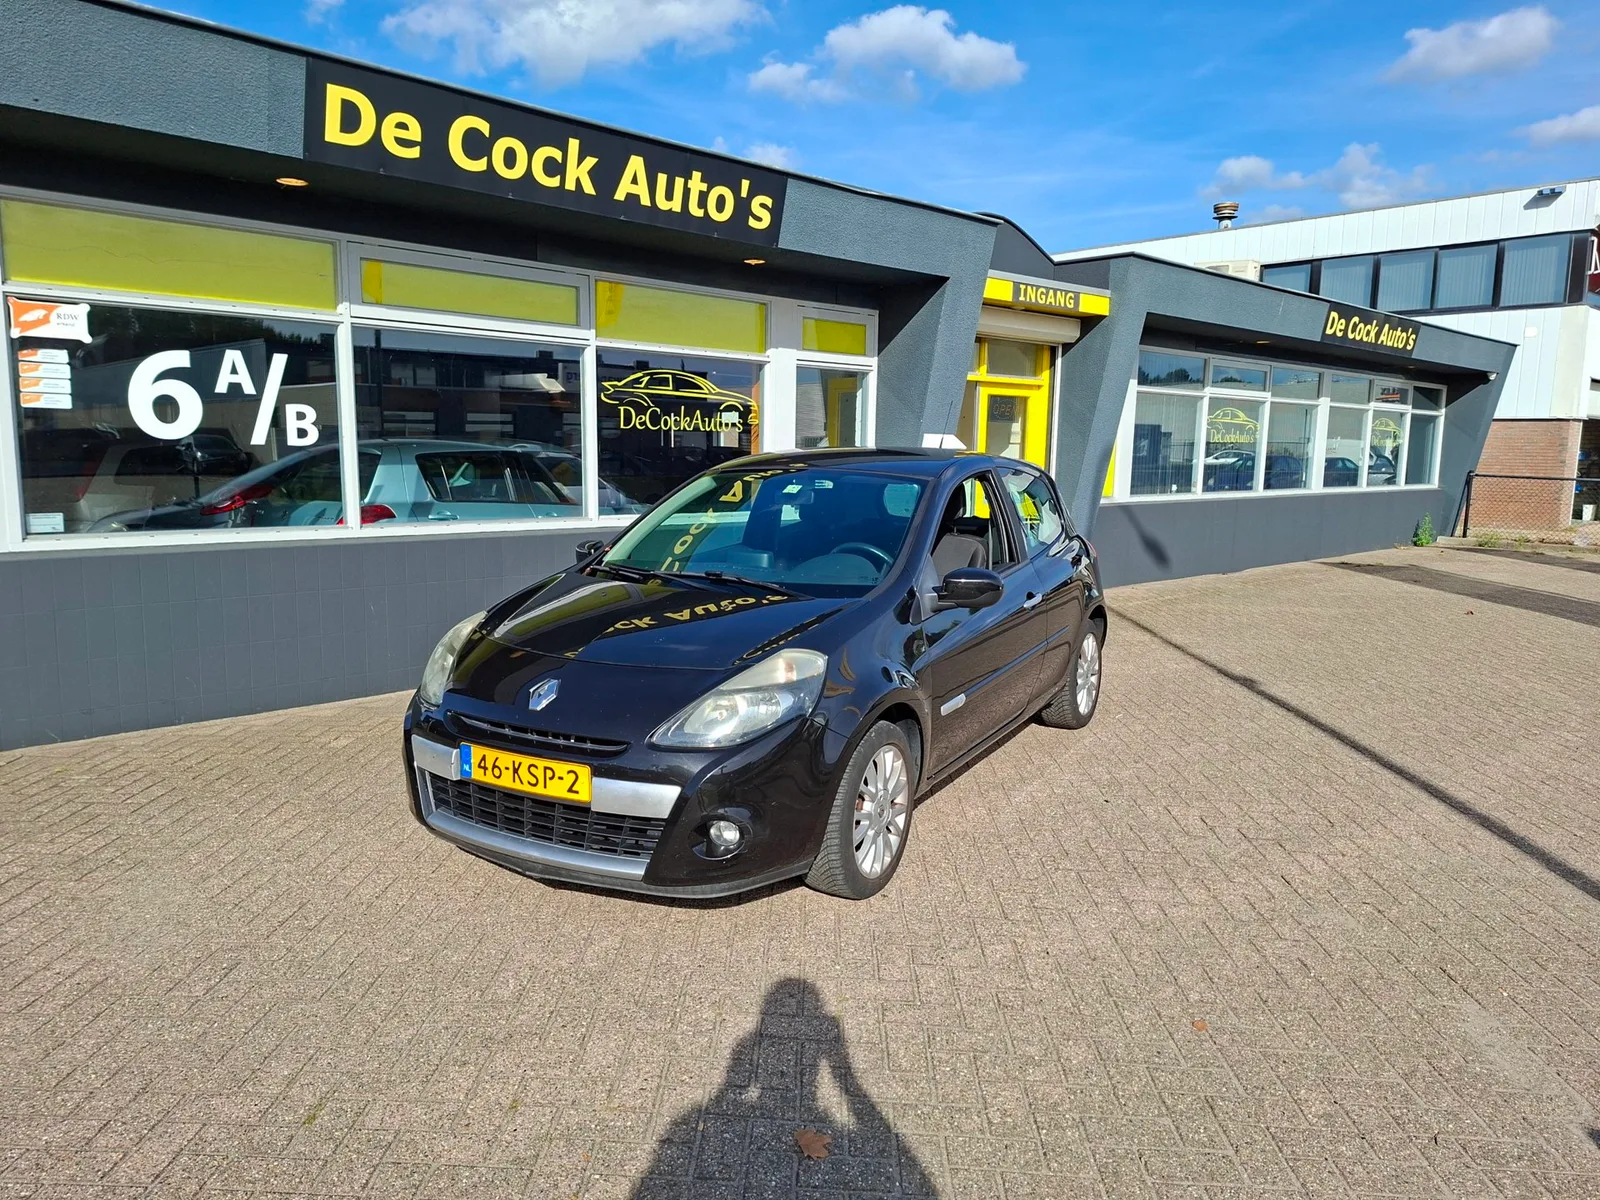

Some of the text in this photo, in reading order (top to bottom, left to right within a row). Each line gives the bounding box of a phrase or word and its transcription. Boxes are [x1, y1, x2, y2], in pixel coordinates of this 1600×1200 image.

[324, 83, 773, 230] De Cock Auto's
[1019, 284, 1074, 308] INGANG
[56, 312, 80, 321] RDW
[1325, 311, 1416, 350] De Cock Auto's
[128, 350, 203, 440] 6
[618, 405, 743, 432] DeCockAuto's
[463, 754, 579, 794] NL 46-KSP-2
